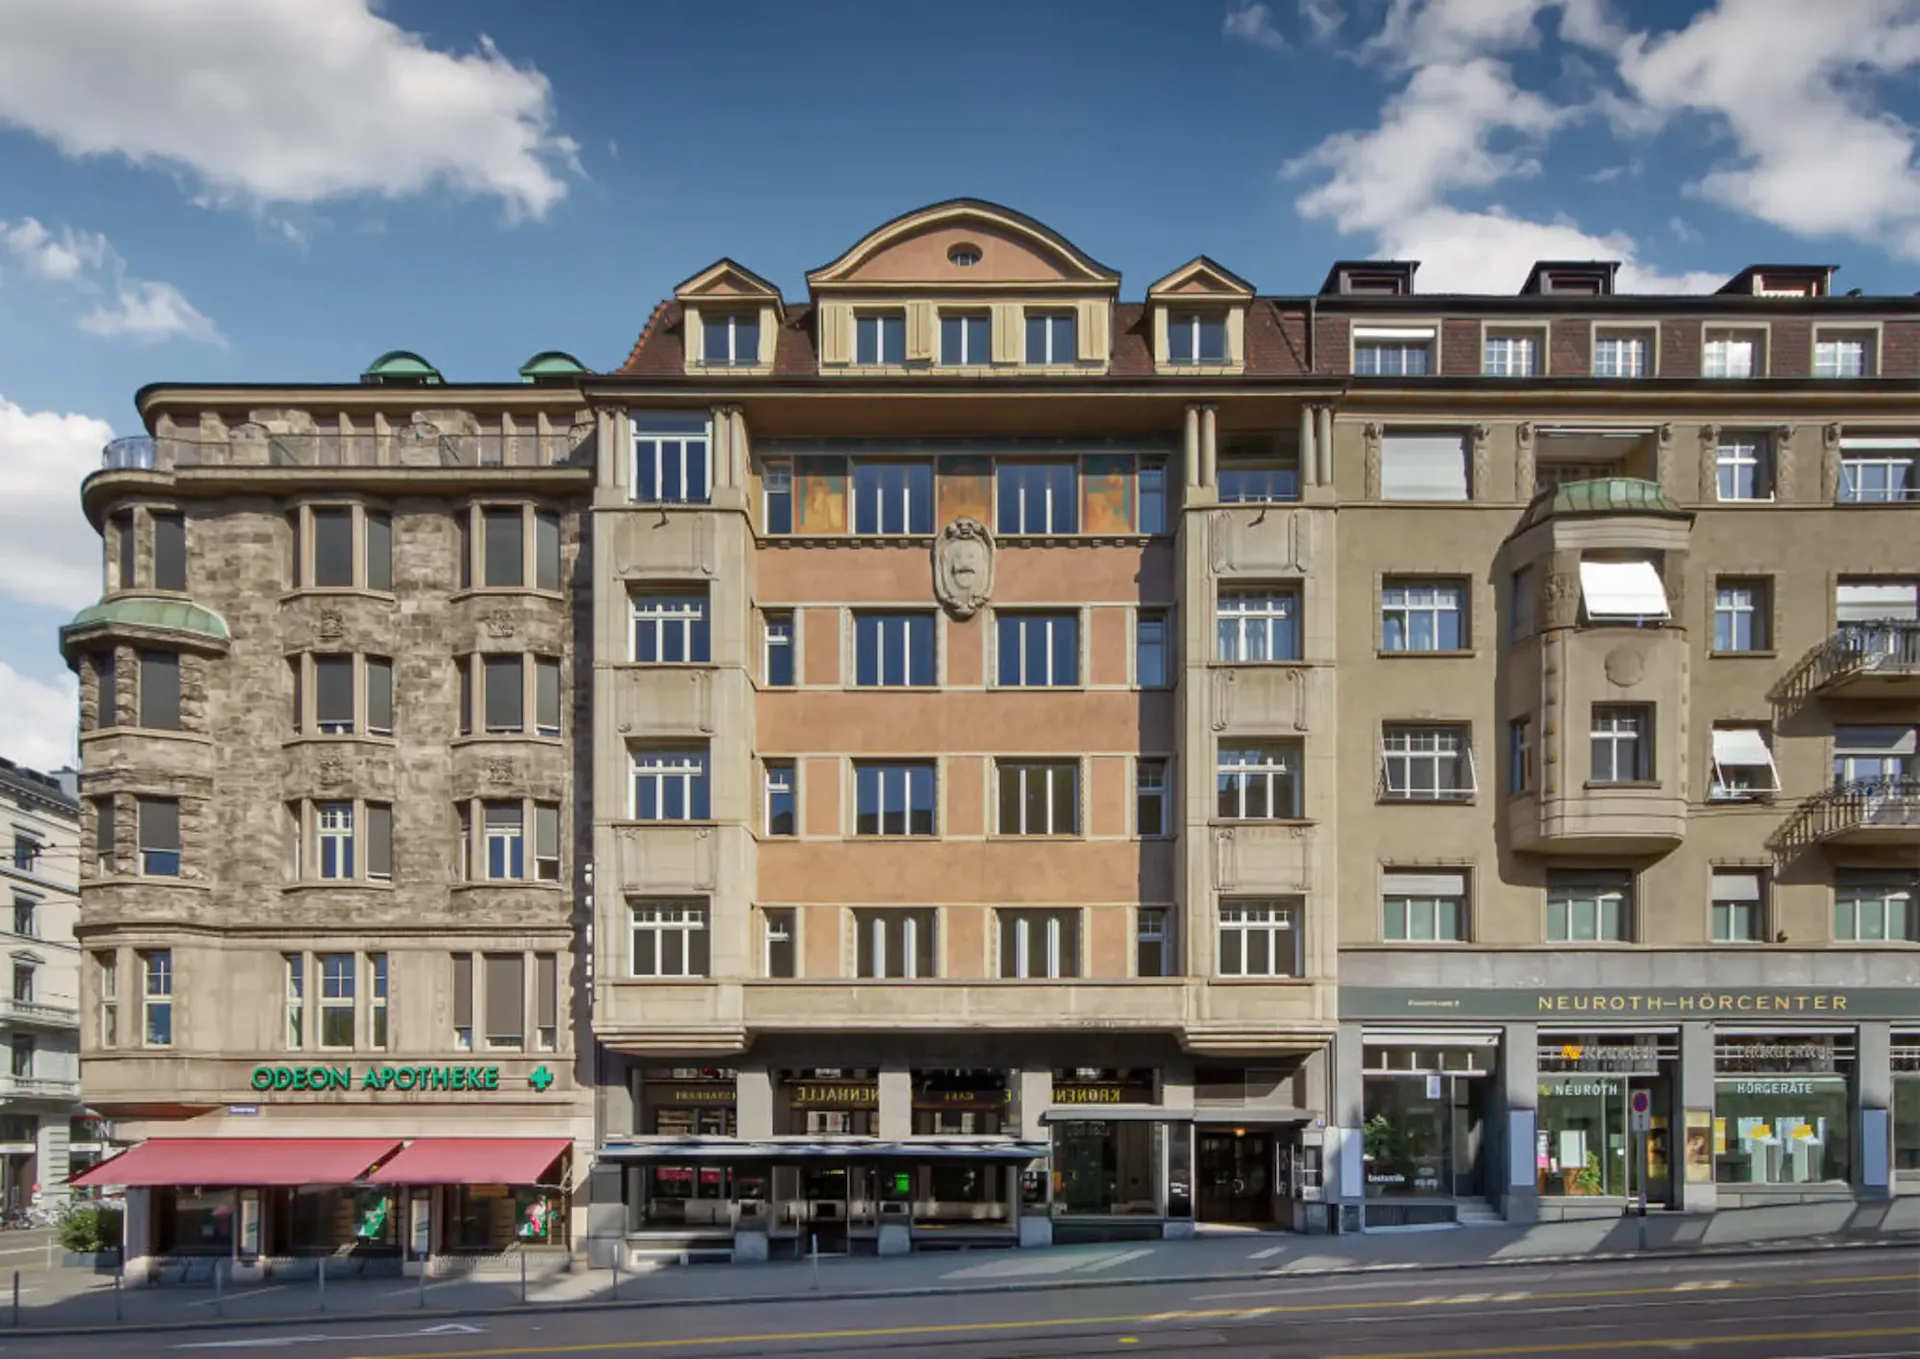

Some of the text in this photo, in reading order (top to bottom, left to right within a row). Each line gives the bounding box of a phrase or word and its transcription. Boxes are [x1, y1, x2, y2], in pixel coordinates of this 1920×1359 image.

[1538, 993, 1848, 1011] NEUROTH-HÖRCENTER
[251, 1066, 500, 1090] ODEON APOTHEKE
[1555, 1084, 1618, 1096] NEUROTH
